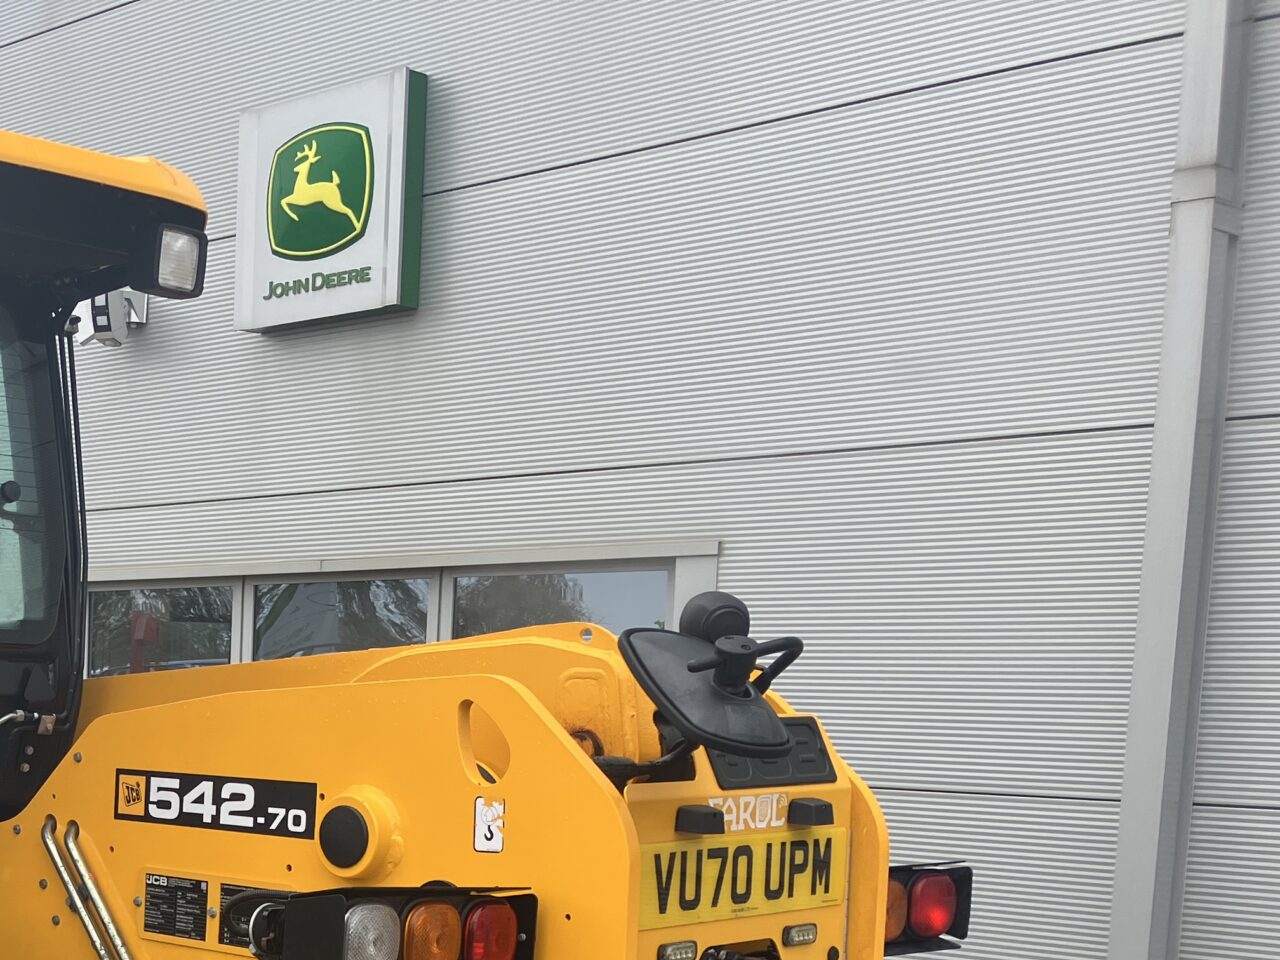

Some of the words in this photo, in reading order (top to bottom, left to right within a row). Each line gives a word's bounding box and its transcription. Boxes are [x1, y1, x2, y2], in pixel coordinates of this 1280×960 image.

[262, 277, 310, 301] JOHN
[311, 266, 372, 292] DEERE
[123, 783, 142, 806] JCB
[146, 875, 168, 887] JCB
[654, 844, 754, 915] VU70
[764, 837, 833, 901] UPM
